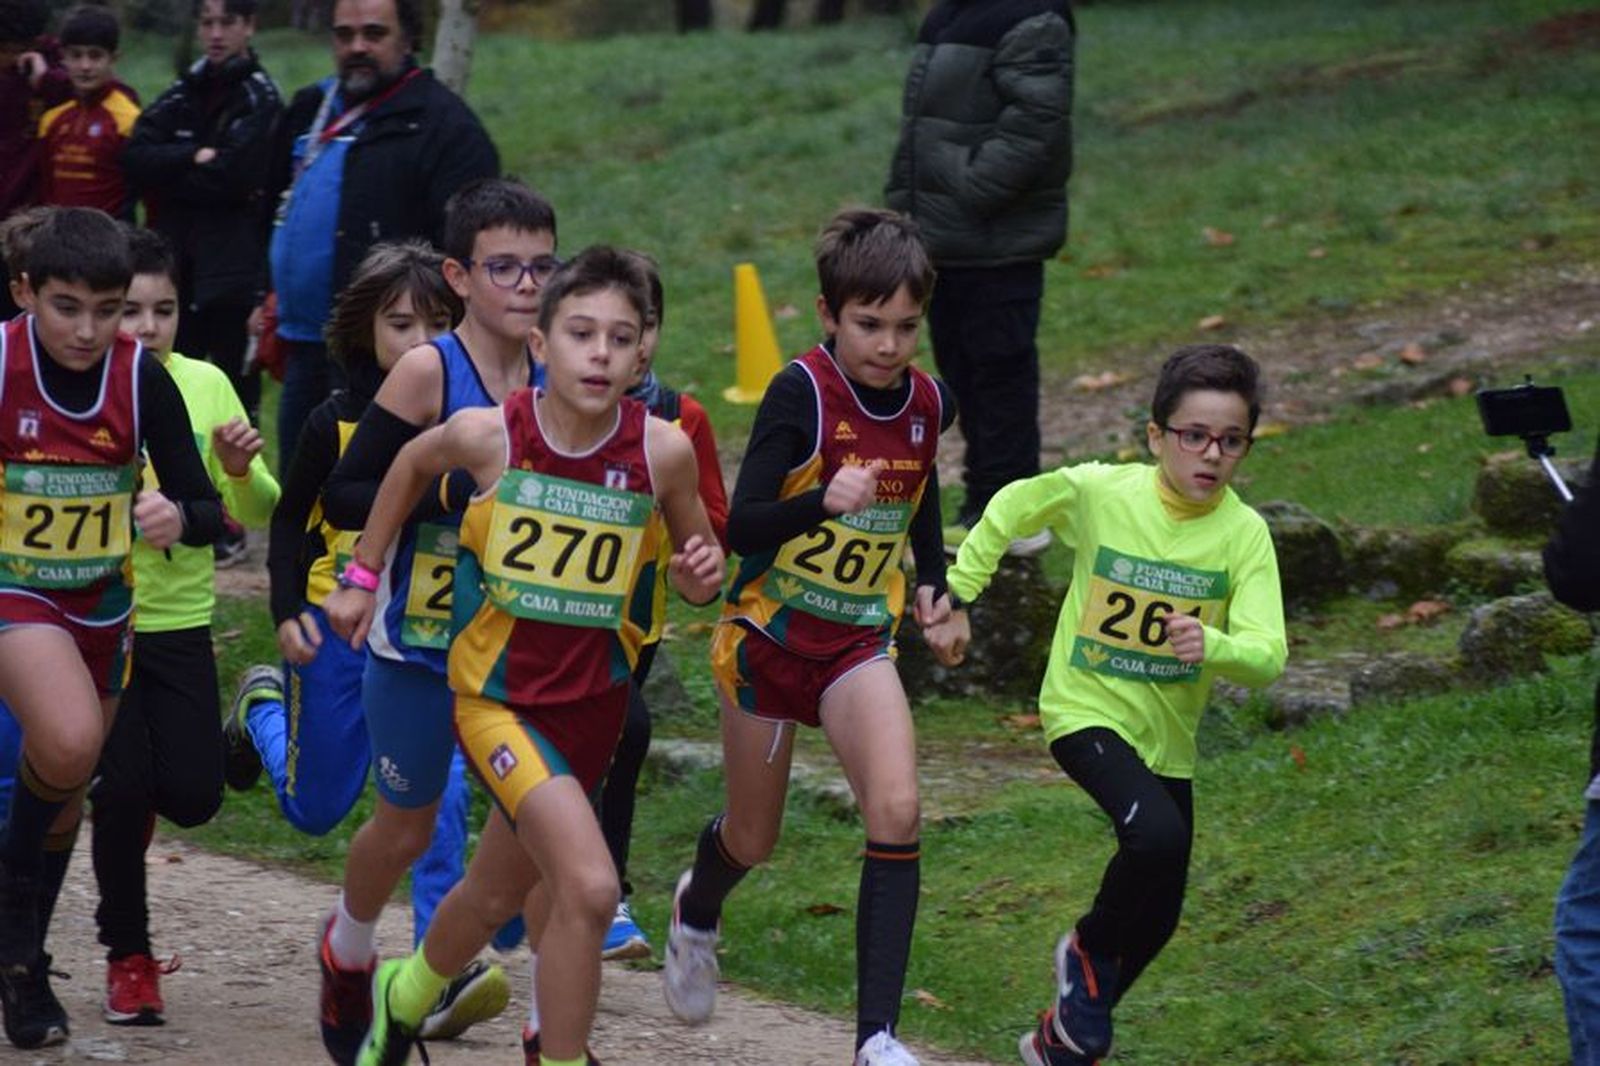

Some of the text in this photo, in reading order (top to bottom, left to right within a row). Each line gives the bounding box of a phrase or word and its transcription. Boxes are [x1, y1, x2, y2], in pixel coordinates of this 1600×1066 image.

[45, 484, 78, 496] CAJA
[544, 497, 630, 523] CAJA RURAL
[23, 502, 111, 550] 271
[502, 517, 623, 584] 270
[793, 525, 897, 588] 267
[37, 567, 72, 580] CAJA
[1134, 575, 1208, 598] CAJA RURAL
[520, 593, 616, 617] CAJA RURAL
[803, 590, 882, 616] CAJA RURAL
[1099, 591, 1202, 647] 26
[1111, 656, 1196, 677] CAJA RURAL
